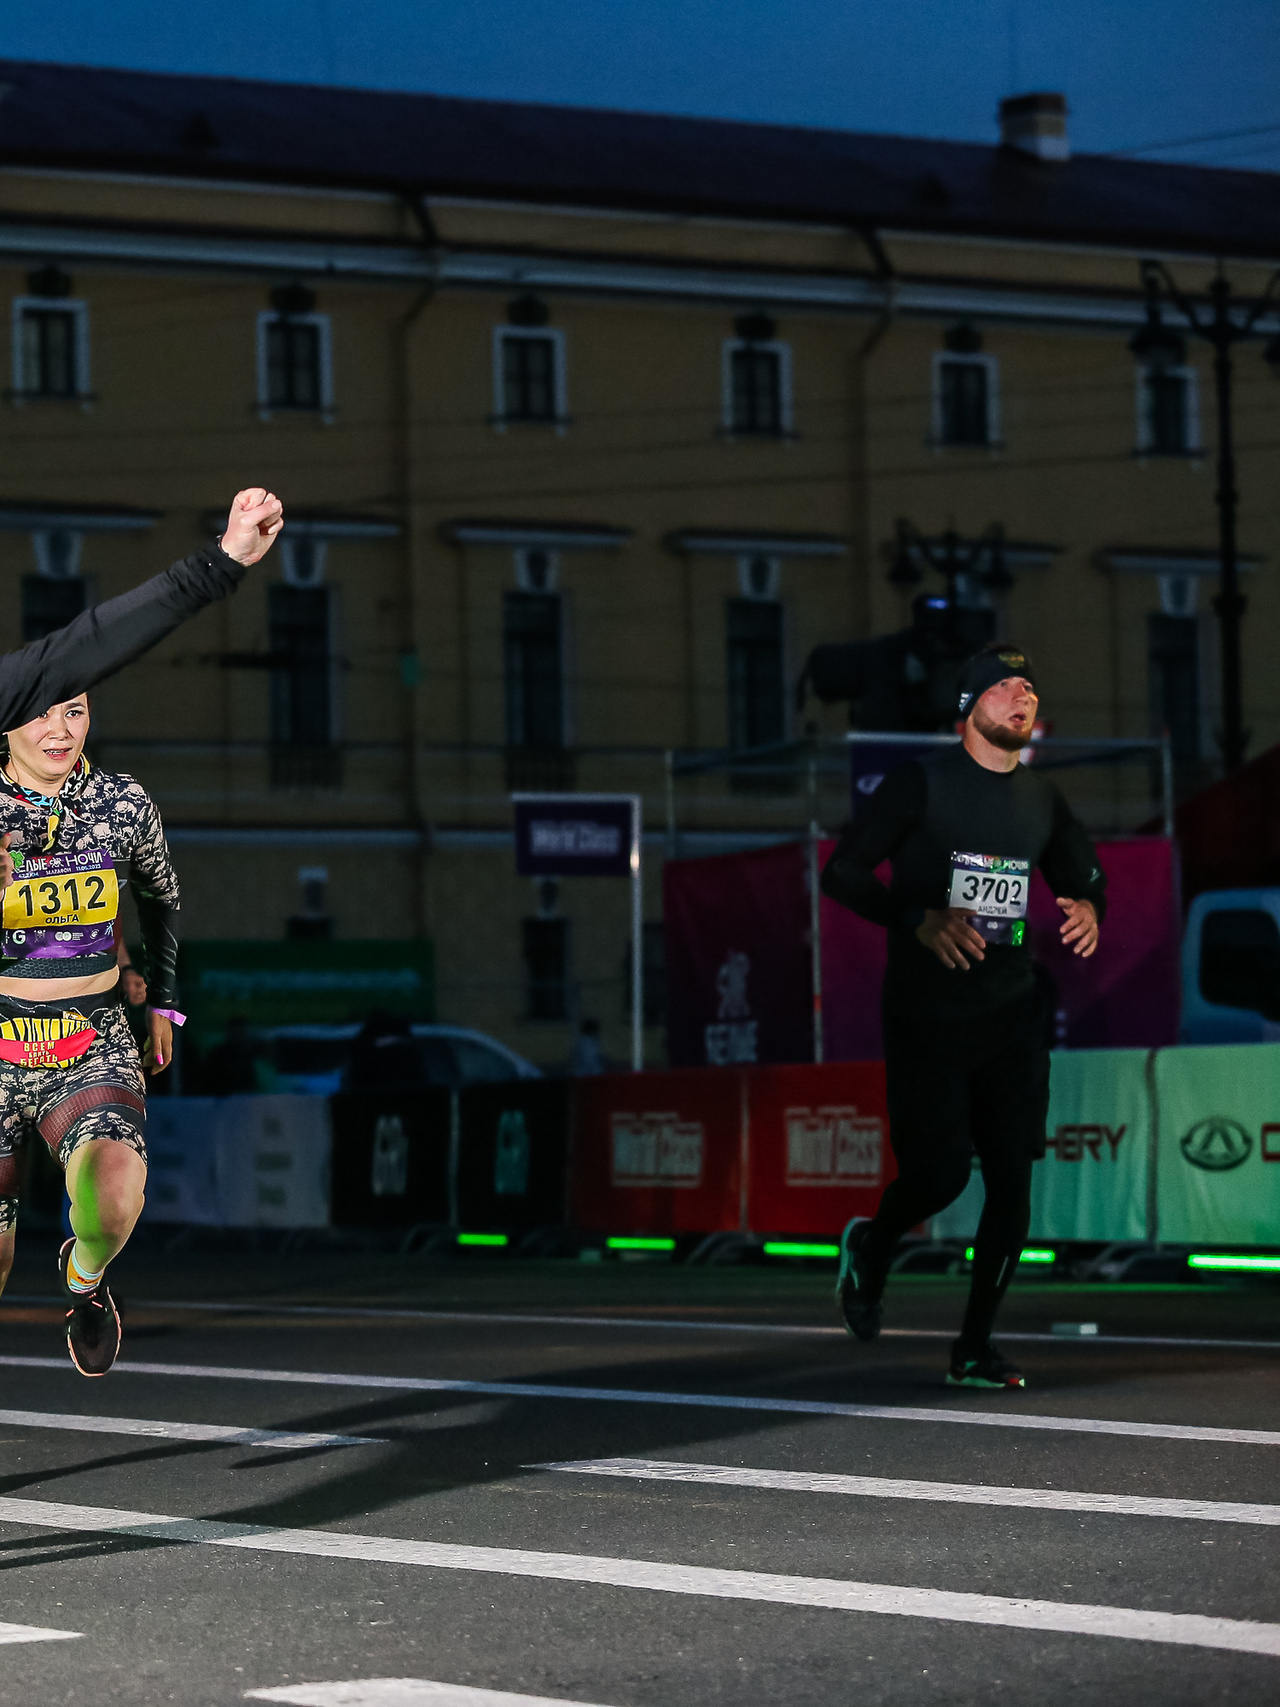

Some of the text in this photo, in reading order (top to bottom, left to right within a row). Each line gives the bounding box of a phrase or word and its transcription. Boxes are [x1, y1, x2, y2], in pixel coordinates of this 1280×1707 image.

[13, 851, 103, 874] ЕЛЫЕ НОЧИ
[18, 876, 106, 917] 1312
[962, 875, 1022, 906] 3702
[45, 914, 80, 925] ОЛЬГА
[12, 930, 26, 945] G
[23, 1041, 55, 1052] ВСЕМ
[20, 1054, 58, 1068] БЕГАТЬ
